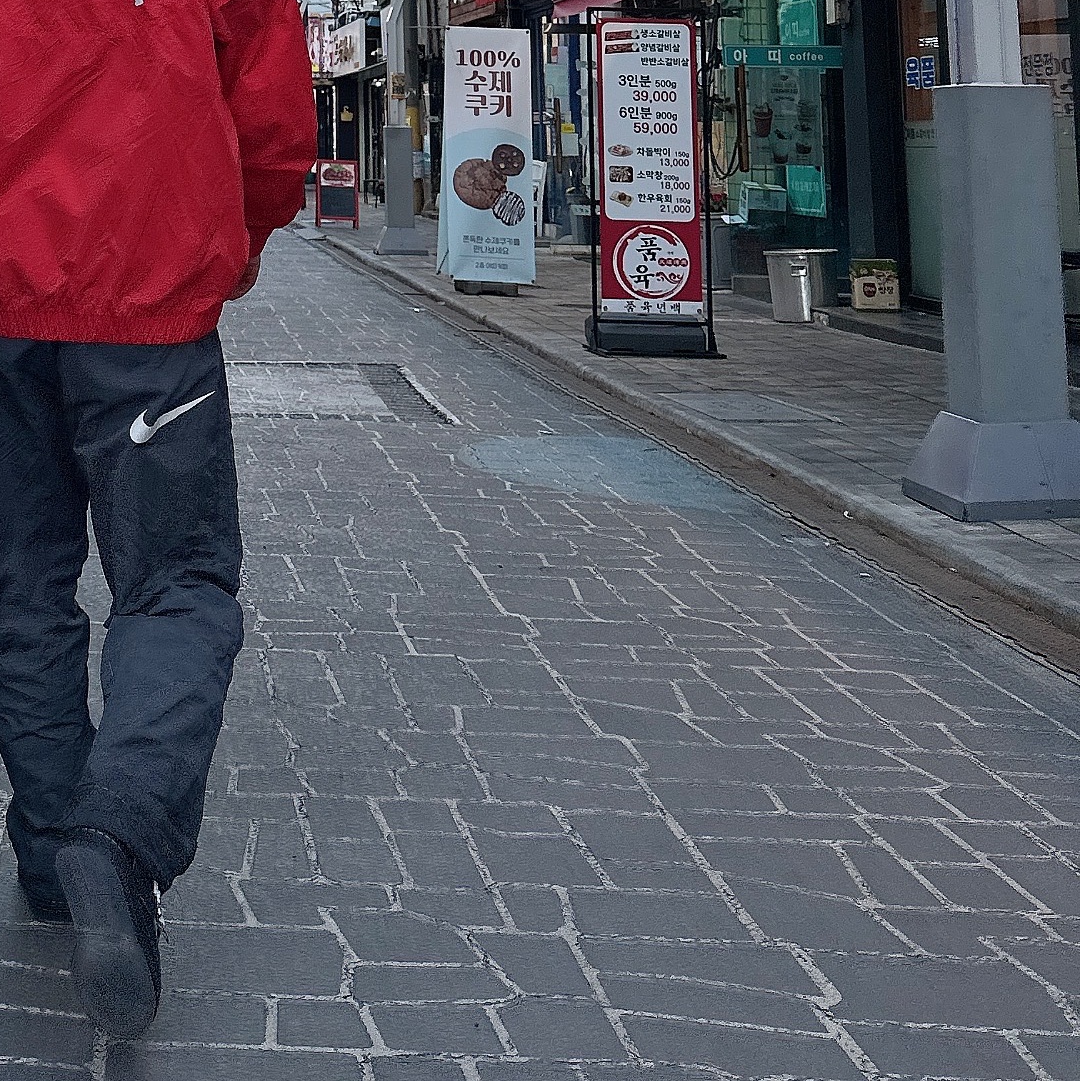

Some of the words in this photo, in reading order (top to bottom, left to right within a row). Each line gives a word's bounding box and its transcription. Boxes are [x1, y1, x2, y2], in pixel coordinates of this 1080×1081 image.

[640, 43, 681, 53] 양념갈비살
[456, 49, 521, 68] 100%
[789, 52, 824, 61] coffee
[640, 57, 689, 67] 반반소갈비살
[464, 70, 512, 93] 수제
[618, 74, 652, 88] 3인분
[655, 80, 677, 89] 500g
[632, 90, 677, 103] 39,000
[465, 94, 512, 117] 쿠키
[619, 107, 652, 120] 6인분
[655, 111, 678, 121] 900g
[633, 122, 678, 135] 59,000
[636, 147, 671, 157] 차돌박이
[660, 158, 689, 167] 13,000
[636, 170, 663, 180] 소막창
[660, 181, 690, 191] 18,000
[637, 193, 673, 203] 한우육회
[660, 205, 691, 214] 21,000
